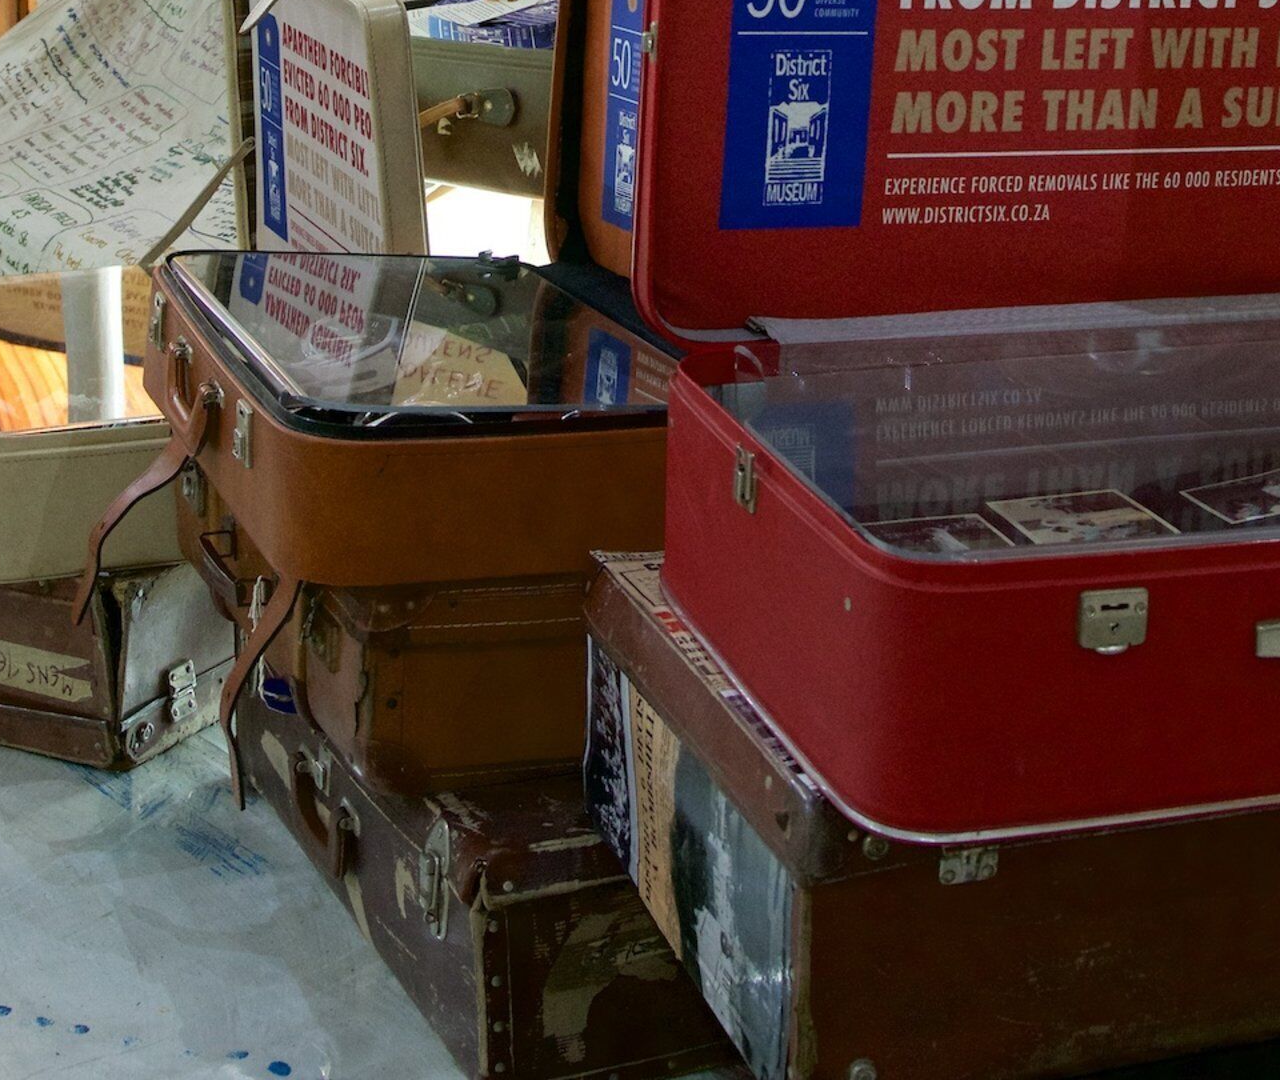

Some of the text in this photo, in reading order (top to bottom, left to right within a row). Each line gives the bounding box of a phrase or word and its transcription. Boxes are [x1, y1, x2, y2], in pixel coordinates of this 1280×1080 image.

[814, 8, 860, 18] COMMUNITY
[282, 22, 328, 71] APARTHEID
[611, 38, 632, 90] 50
[895, 29, 1024, 72] MOST
[1042, 28, 1133, 70] LEFT
[1152, 28, 1259, 68] WITH
[775, 53, 827, 76] District
[283, 57, 351, 125] EVICTED 60 000
[788, 78, 810, 101] Six
[892, 90, 1024, 134] MORE
[1043, 89, 1157, 131] THAN
[1175, 88, 1203, 129] A
[284, 95, 370, 178] FROM DISTRICT SIX.
[766, 182, 818, 203] MUSEUM
[883, 176, 967, 196] EXPERIENCE
[970, 174, 1024, 195] FORCED
[1027, 172, 1098, 193] REMOVALS
[1101, 172, 1131, 191] LIKE
[1135, 171, 1160, 190] THE
[1162, 170, 1182, 190] 60
[1184, 170, 1211, 189] 000
[881, 203, 1051, 226] WWW.DISTRICTSIX.CO.ZA
